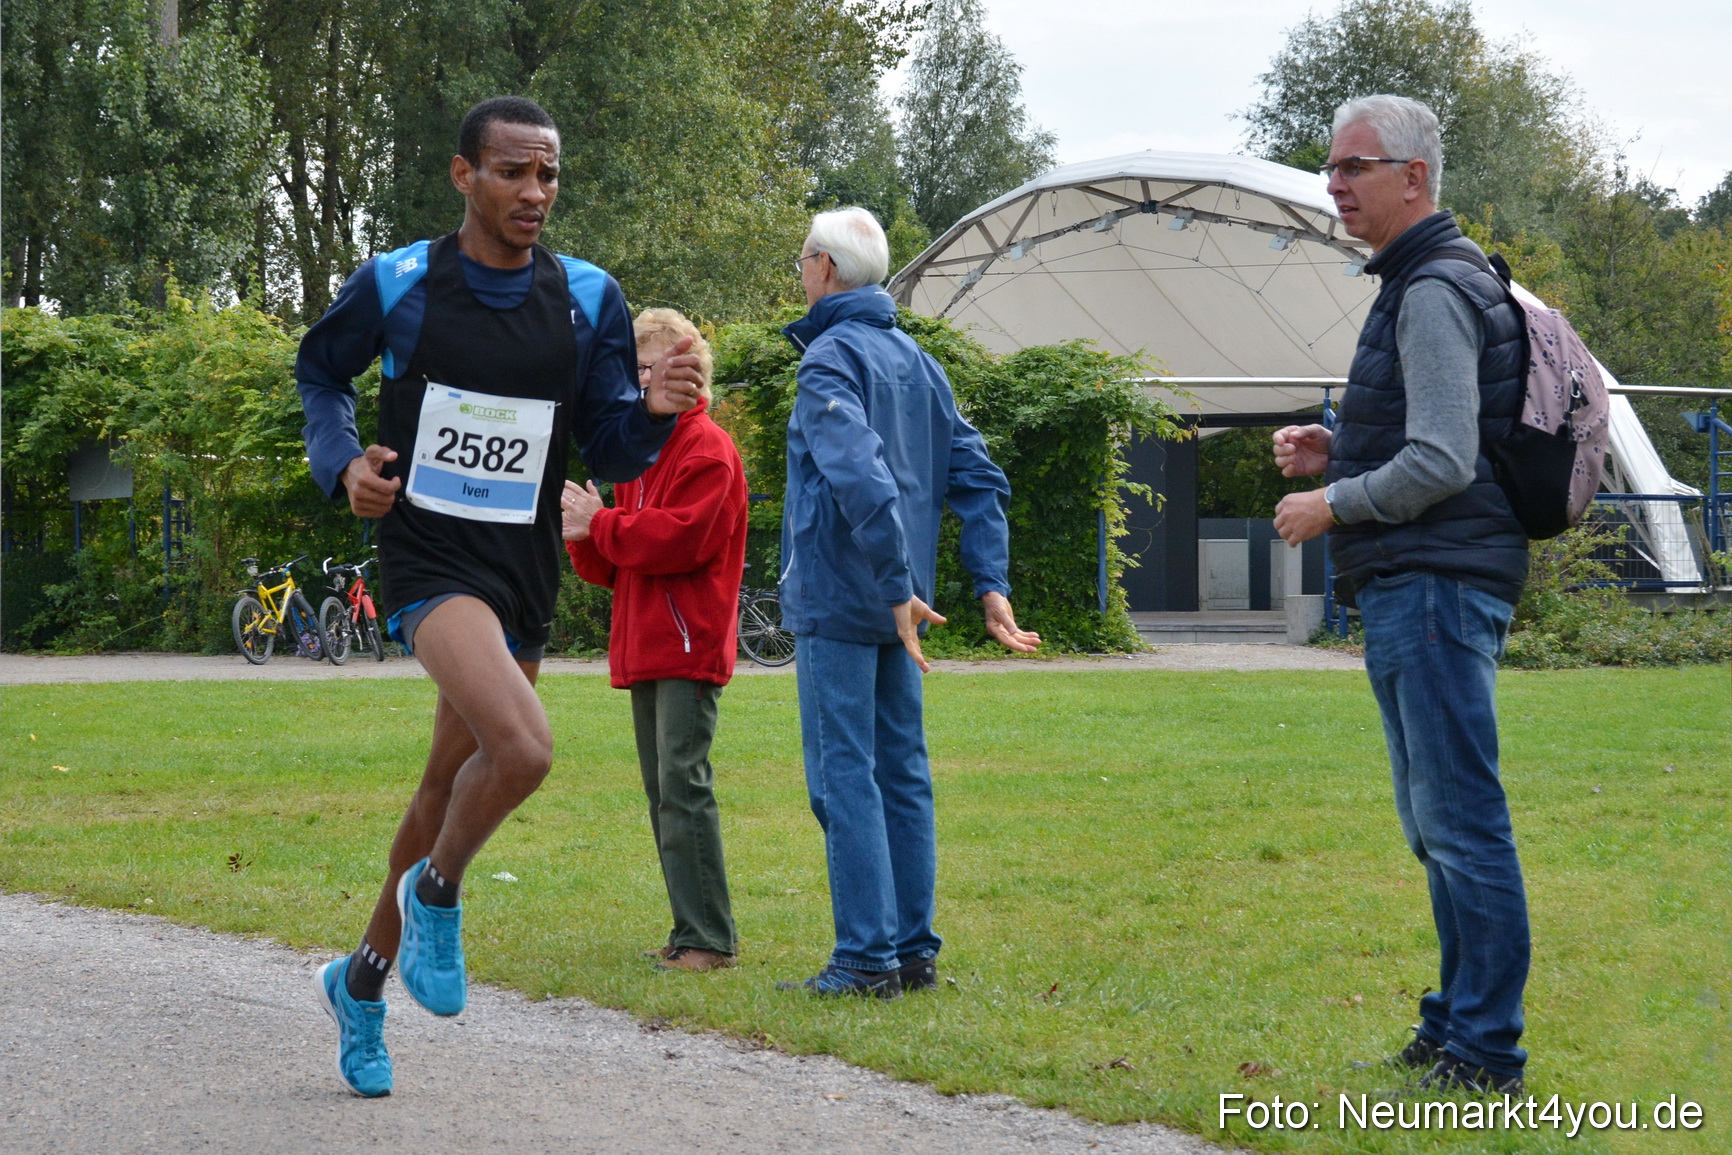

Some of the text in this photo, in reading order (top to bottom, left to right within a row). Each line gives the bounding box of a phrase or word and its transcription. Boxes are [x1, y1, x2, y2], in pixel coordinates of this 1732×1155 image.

[473, 405, 517, 420] BOCK
[434, 427, 529, 474] 2582
[462, 482, 489, 498] Iven
